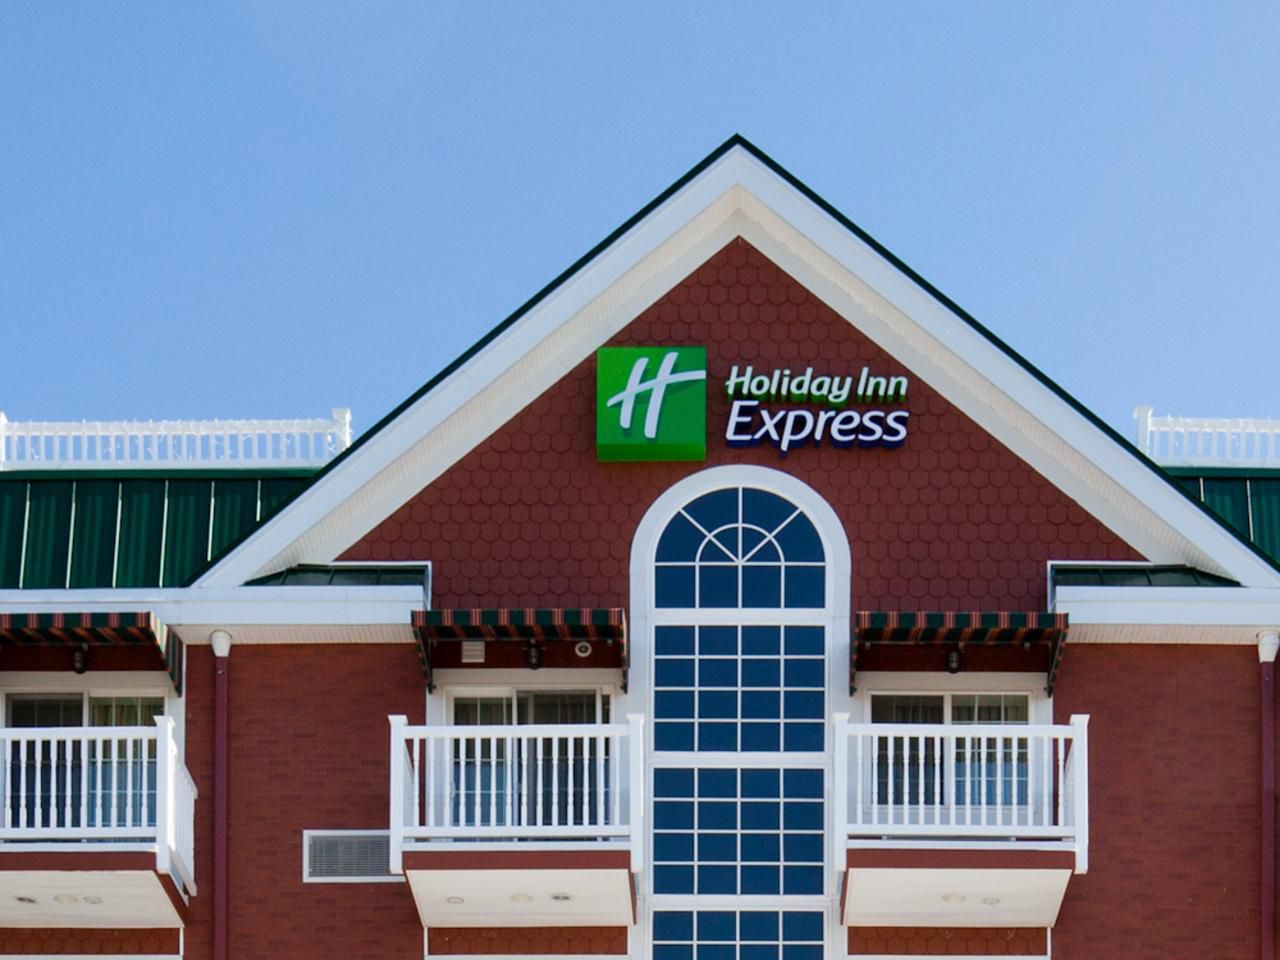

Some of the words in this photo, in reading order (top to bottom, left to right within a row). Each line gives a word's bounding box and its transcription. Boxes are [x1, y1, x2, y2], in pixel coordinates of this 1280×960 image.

[726, 366, 852, 402] Holiday
[857, 367, 908, 397] Inn
[725, 400, 909, 452] Express
